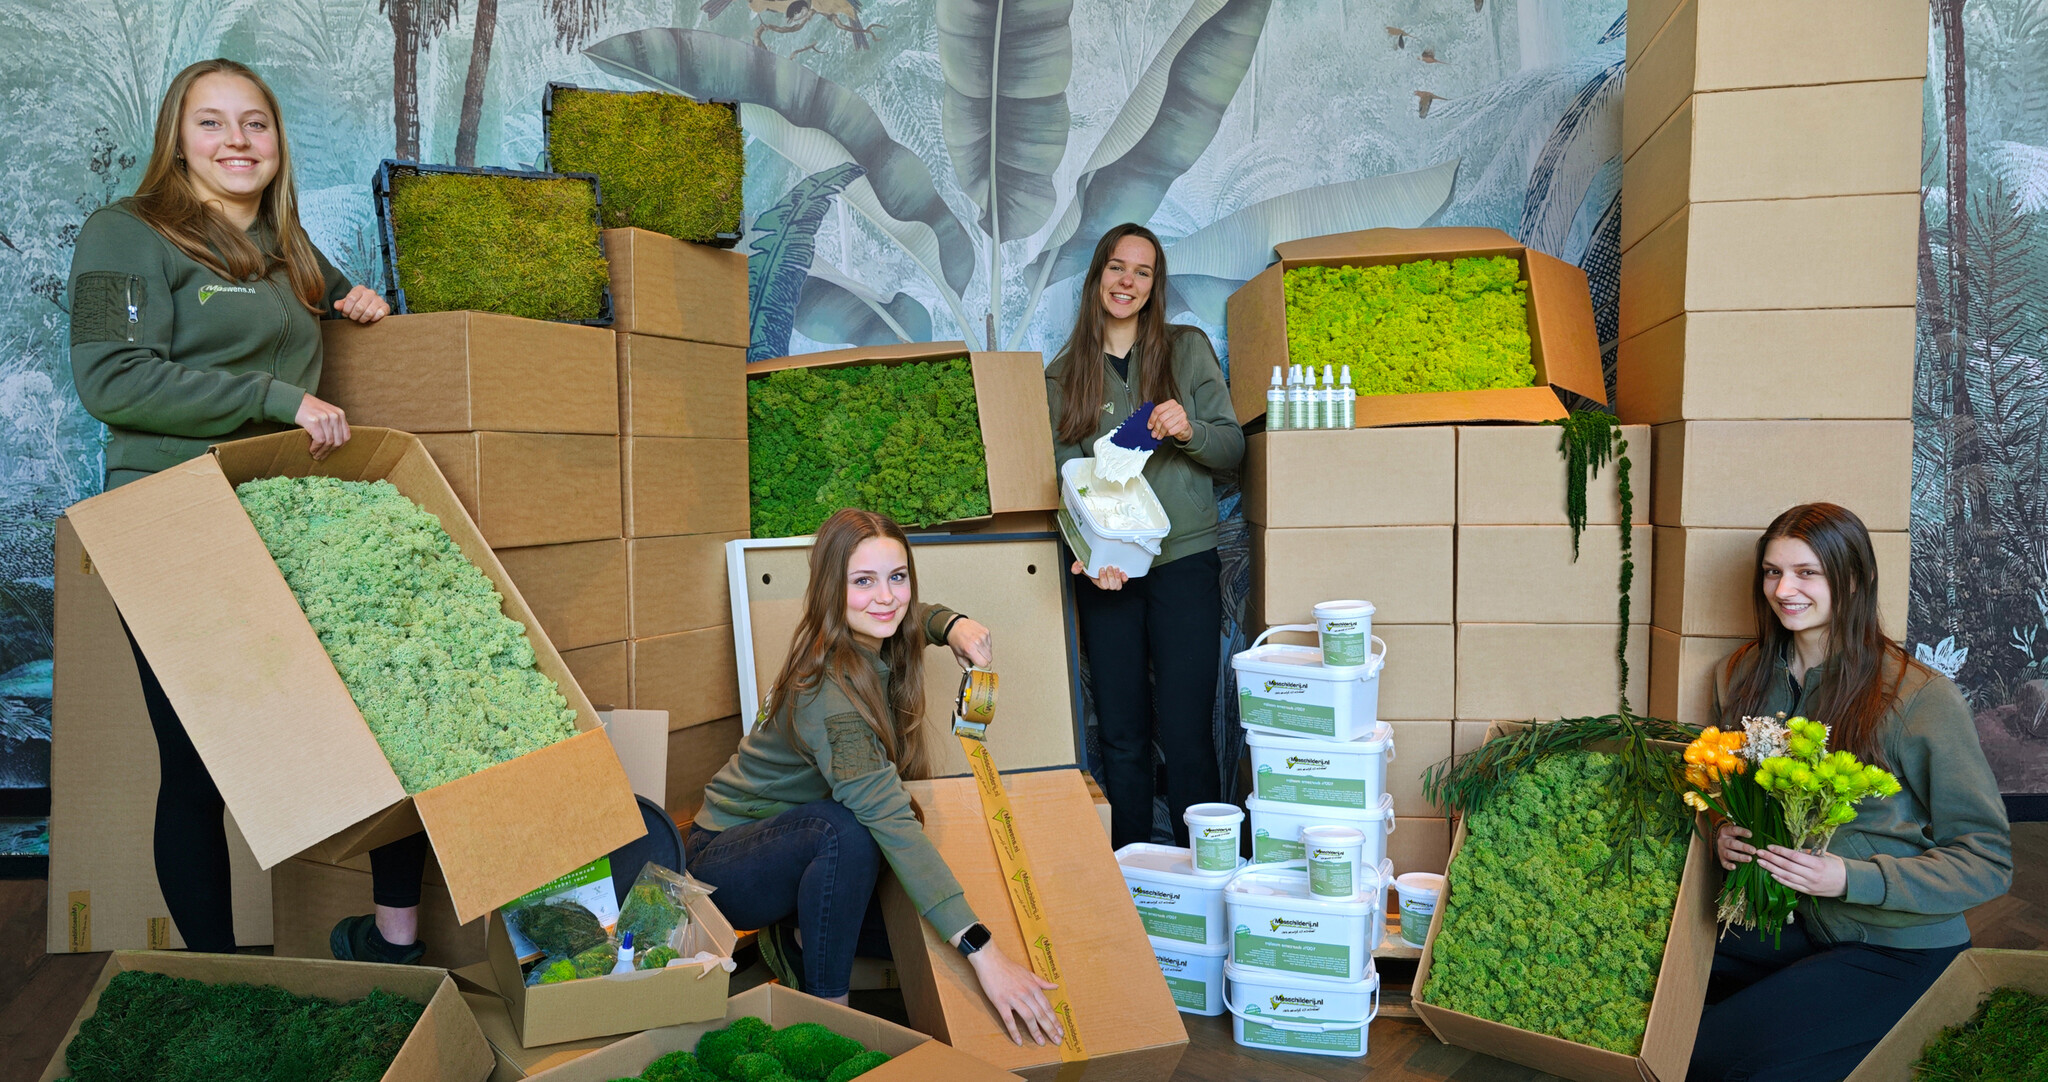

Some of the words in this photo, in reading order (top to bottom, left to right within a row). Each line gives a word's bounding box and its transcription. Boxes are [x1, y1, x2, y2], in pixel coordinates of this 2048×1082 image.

[205, 284, 256, 294] Moswens.nl
[1268, 680, 1308, 690] Mosschilderij.nl
[1291, 757, 1330, 766] Mosschilderij.nl
[982, 749, 1000, 797] Mosschilderij.nl
[1003, 812, 1020, 853] Moswens.nl
[1021, 871, 1041, 921] Mosschilderij.nl
[1132, 886, 1181, 900] Mosschilderij.nl
[1275, 918, 1319, 928] Mosschilderij.nl
[1043, 939, 1060, 981] Moswens.nl
[1156, 956, 1188, 967] childerij.nl
[1275, 995, 1324, 1006] Mosschilderij.nl
[1063, 1004, 1082, 1054] Mosschilderij.nl
